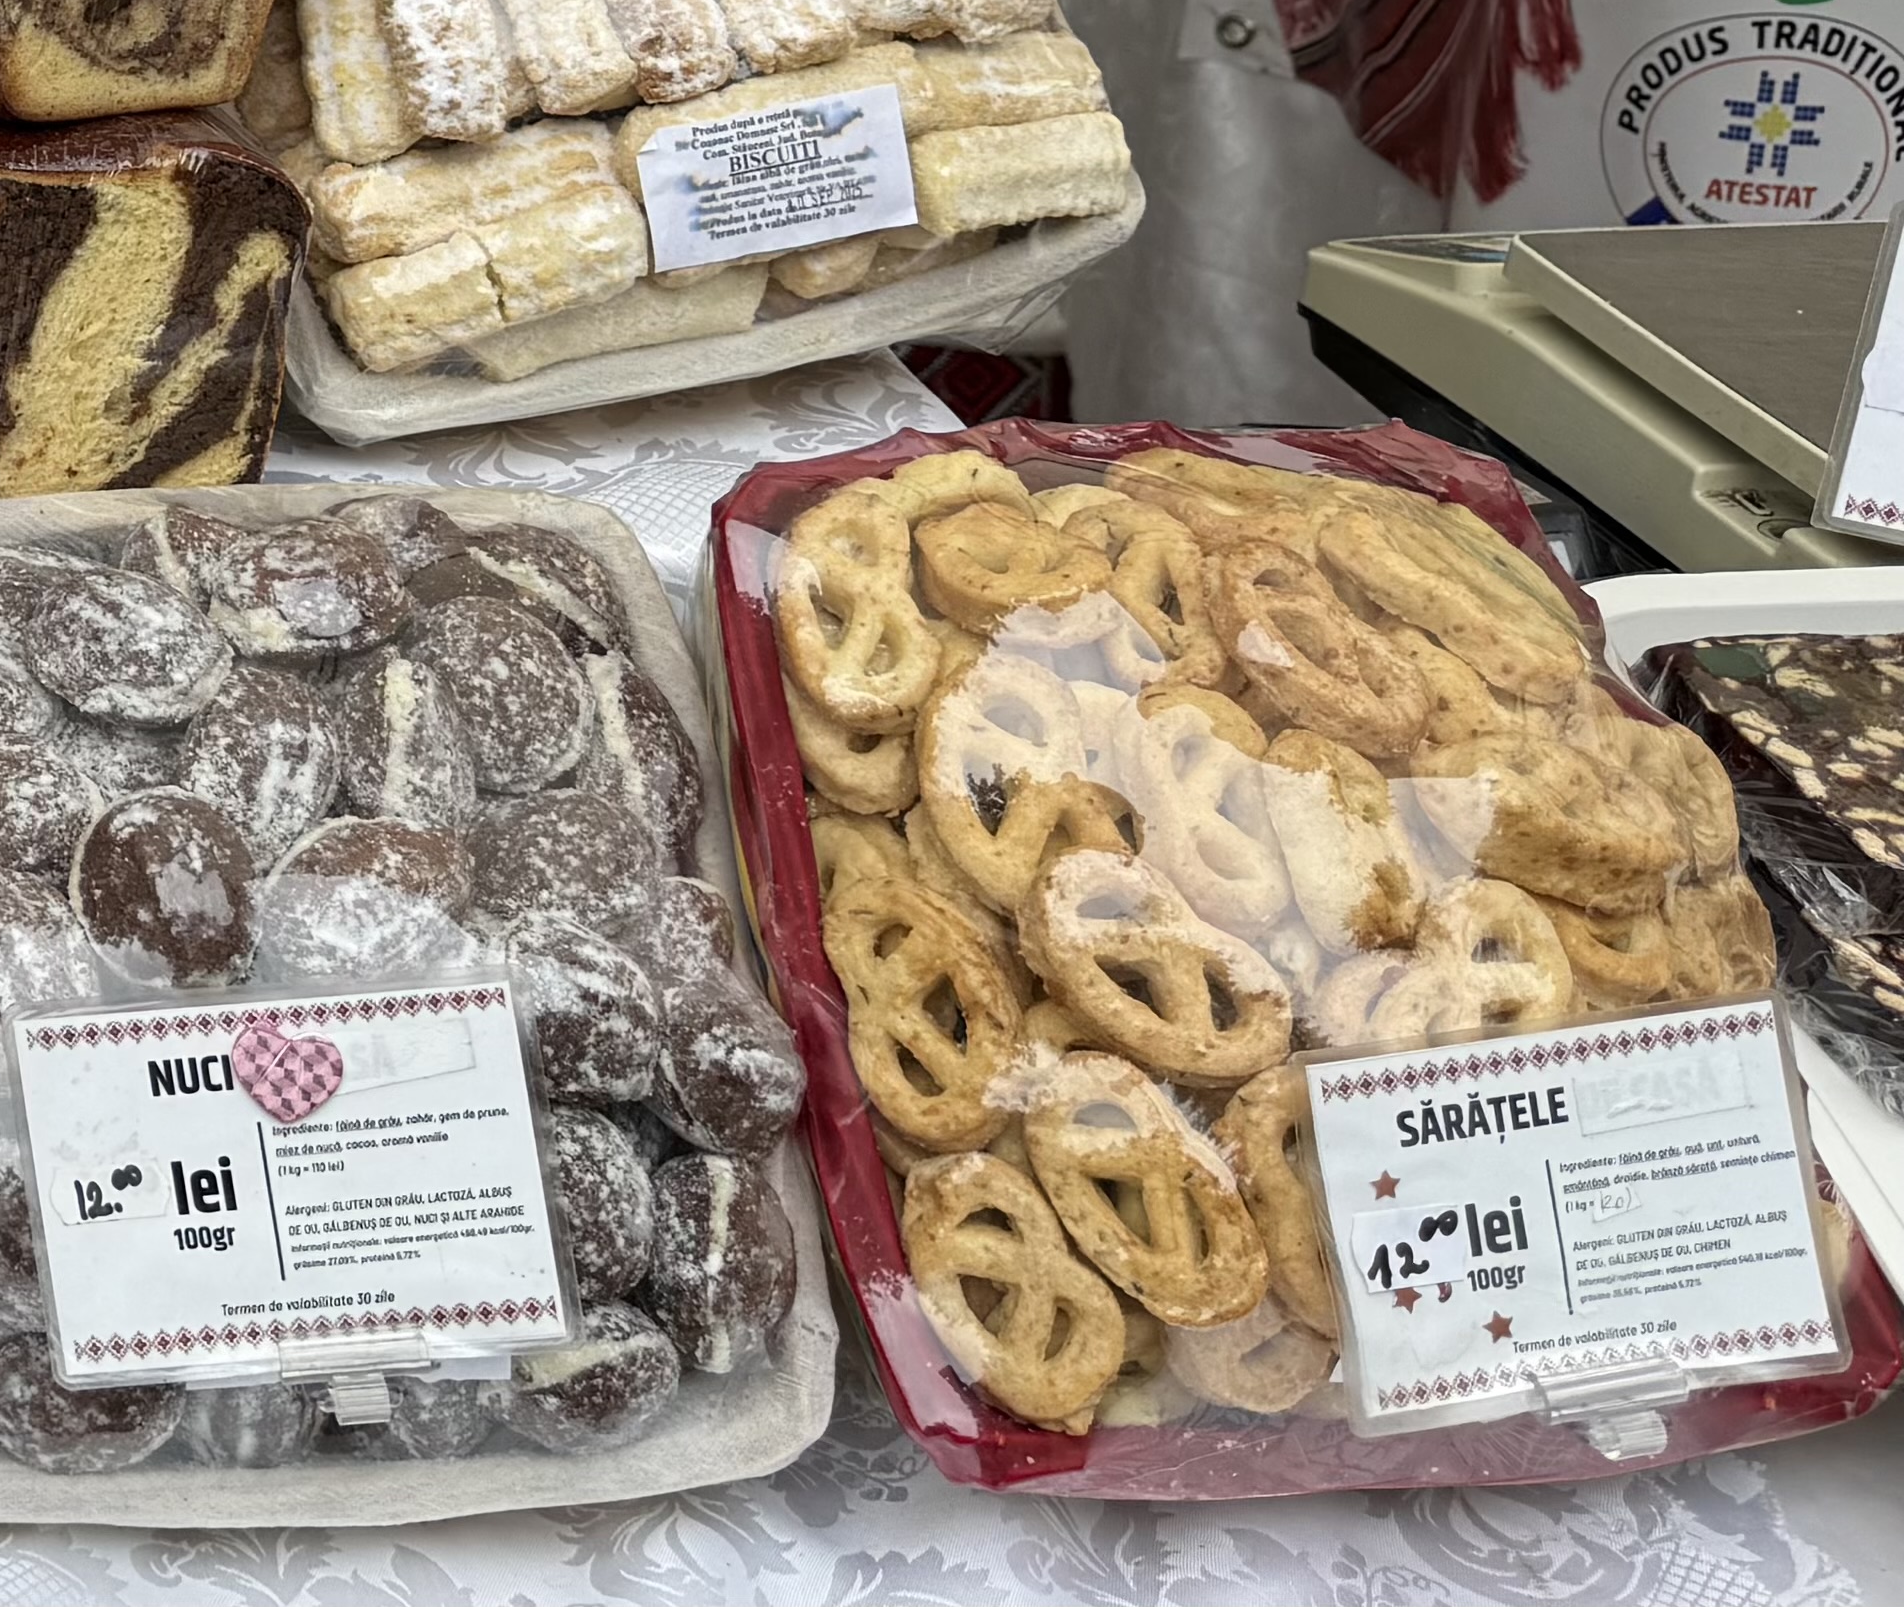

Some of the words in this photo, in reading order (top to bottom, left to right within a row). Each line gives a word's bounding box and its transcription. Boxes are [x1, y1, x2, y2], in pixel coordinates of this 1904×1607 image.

[1618, 26, 1730, 135] PRODUS
[729, 140, 821, 173] BISCUITI
[1704, 178, 1818, 210] ATESTAT
[147, 1054, 235, 1098] NUCI
[171, 1155, 238, 1216] lei
[173, 1223, 237, 1252] 100gr
[1465, 1195, 1529, 1258] lei
[1467, 1262, 1526, 1293] 100gr
[221, 1303, 265, 1316] Termen
[269, 1300, 283, 1312] de
[357, 1292, 371, 1305] 30
[1513, 1339, 1555, 1354] Termen
[1558, 1335, 1571, 1347] de
[1641, 1321, 1654, 1334] 30
